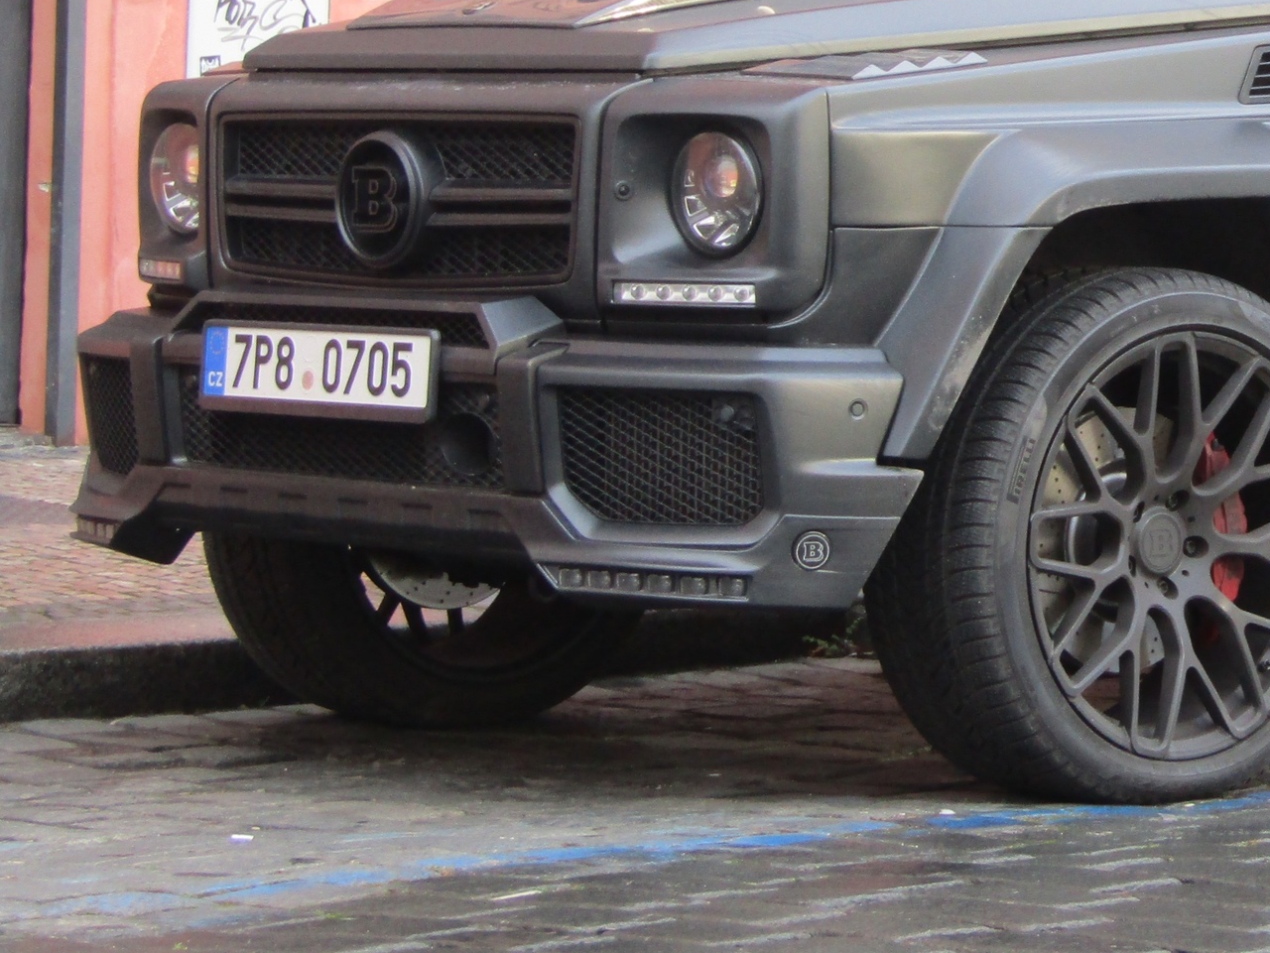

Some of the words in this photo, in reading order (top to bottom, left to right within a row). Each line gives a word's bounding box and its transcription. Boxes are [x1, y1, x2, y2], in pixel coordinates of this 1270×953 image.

[352, 165, 398, 233] B
[208, 370, 223, 387] CZ
[232, 333, 296, 391] 7P8
[321, 337, 414, 398] 0705
[803, 541, 825, 562] B
